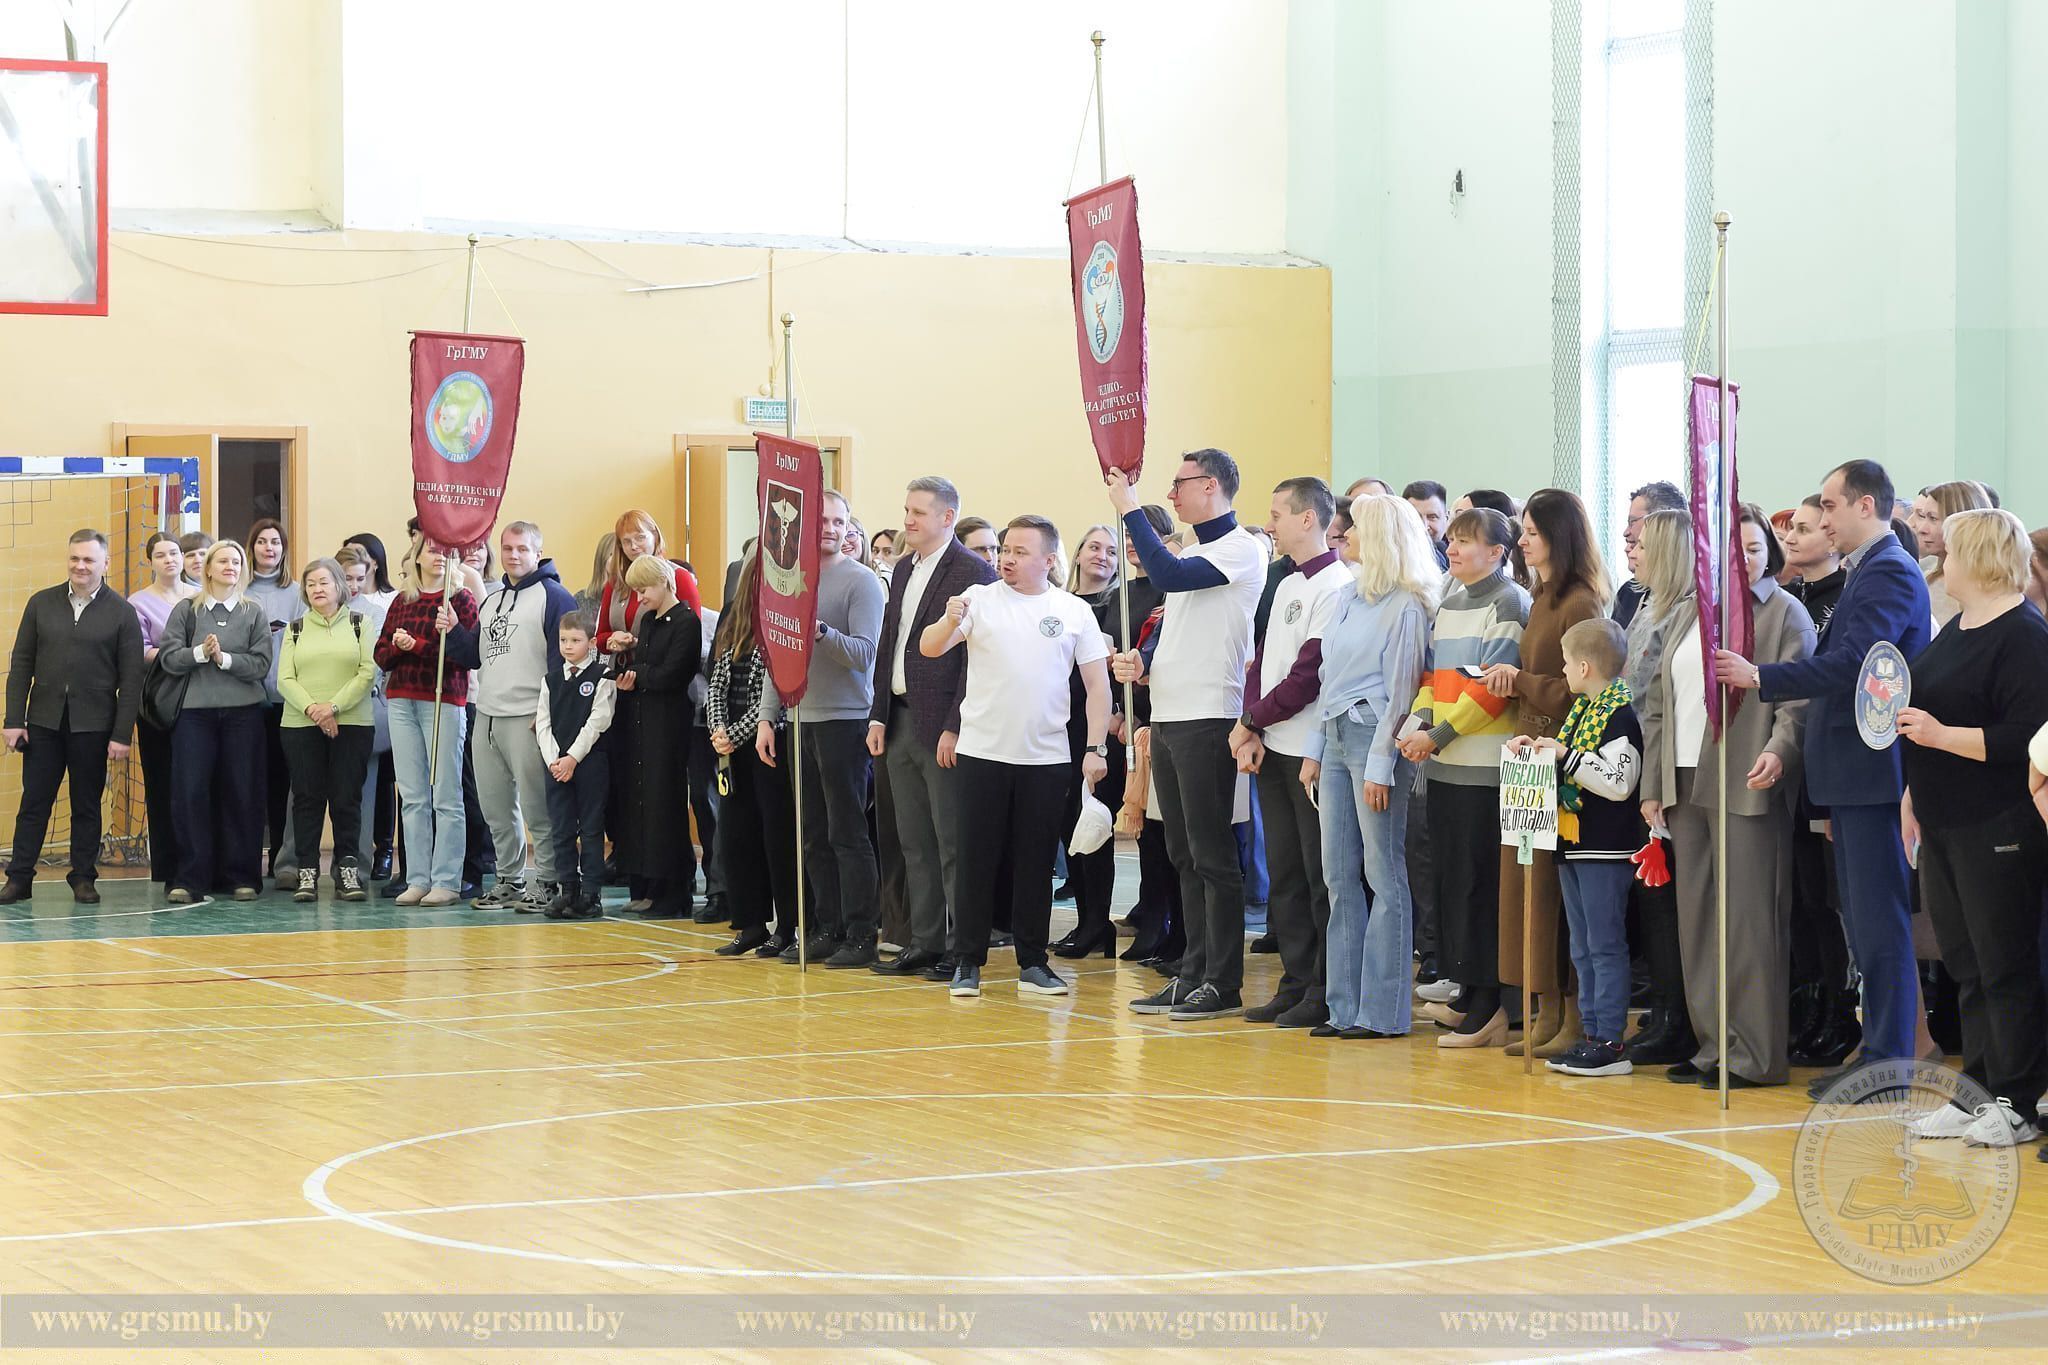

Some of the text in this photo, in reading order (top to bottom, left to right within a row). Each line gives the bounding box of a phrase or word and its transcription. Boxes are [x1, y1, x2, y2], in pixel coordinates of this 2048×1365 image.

[445, 345, 489, 360] ГрГМУ
[416, 481, 501, 498] ПЕДИАТРИЧЕСКИЙ
[427, 494, 486, 507] ФАКУЛЬТЕТ
[1504, 786, 1545, 809] КУБОК
